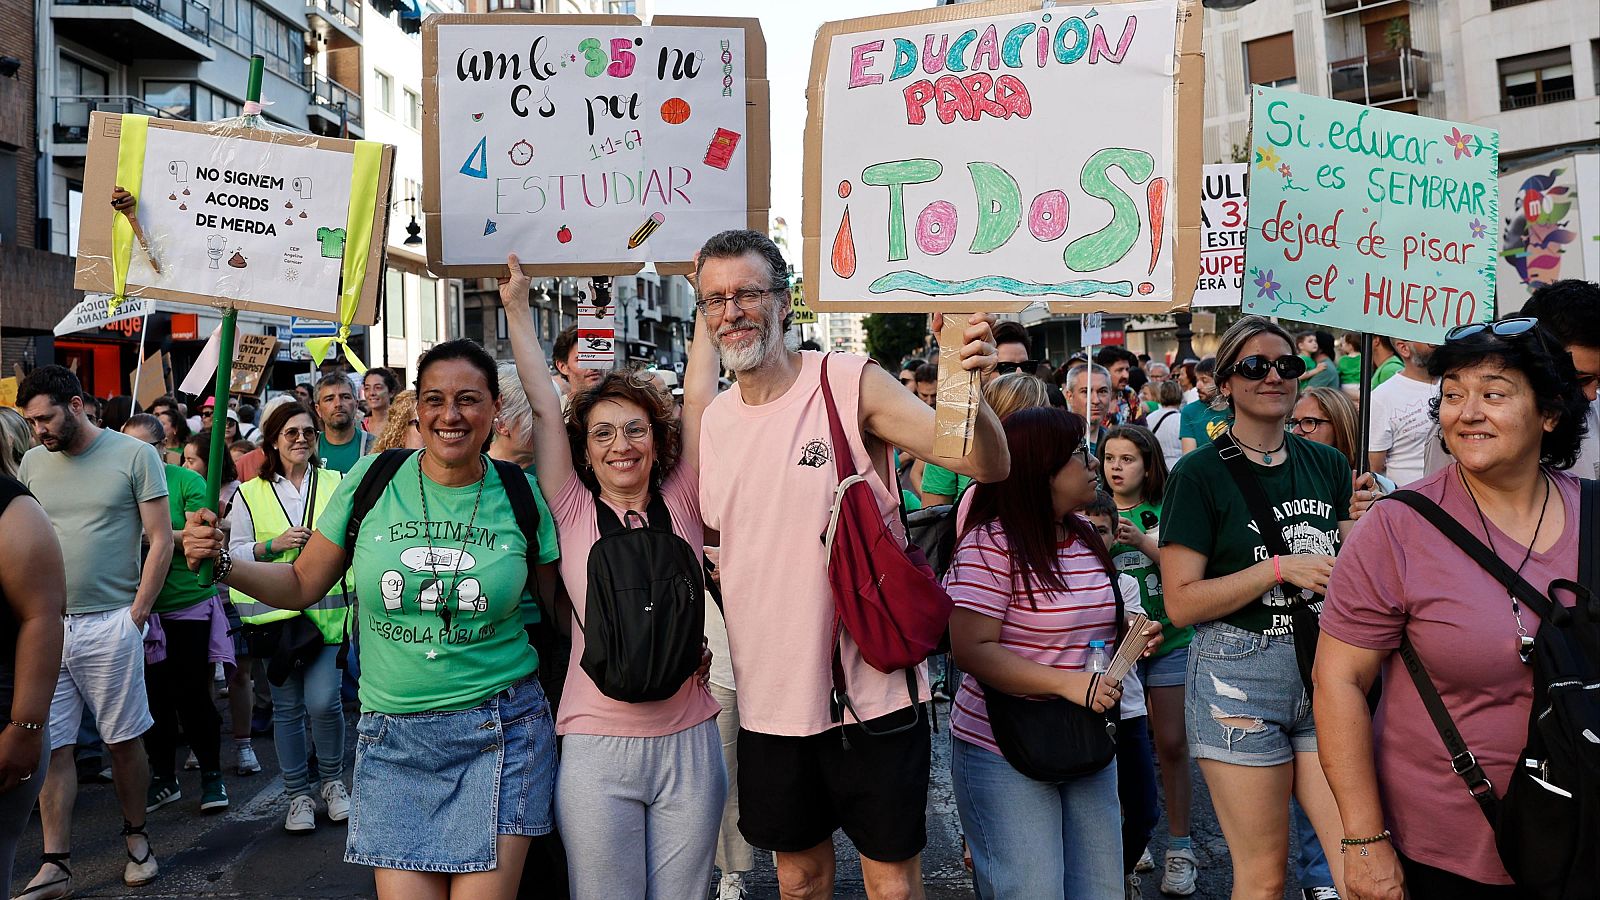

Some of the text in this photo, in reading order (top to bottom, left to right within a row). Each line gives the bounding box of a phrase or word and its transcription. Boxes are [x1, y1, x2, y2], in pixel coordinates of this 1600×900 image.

[456, 35, 557, 82] amb
[657, 46, 705, 82] no
[585, 92, 642, 136] pot
[903, 72, 1032, 125] PARA
[1267, 101, 1312, 148] Si
[196, 166, 284, 190] NO SIGNEM
[496, 166, 692, 215] ESTUDIAR
[1317, 164, 1486, 216] es SEMBRAR
[195, 213, 277, 237] DE MERDA
[205, 192, 269, 212] ACORDS
[1261, 200, 1476, 270] dejad de pisar
[1305, 264, 1476, 327] el HUERTO
[388, 521, 498, 551] ESTIMEM
[368, 614, 434, 644] L'ESCOLA
